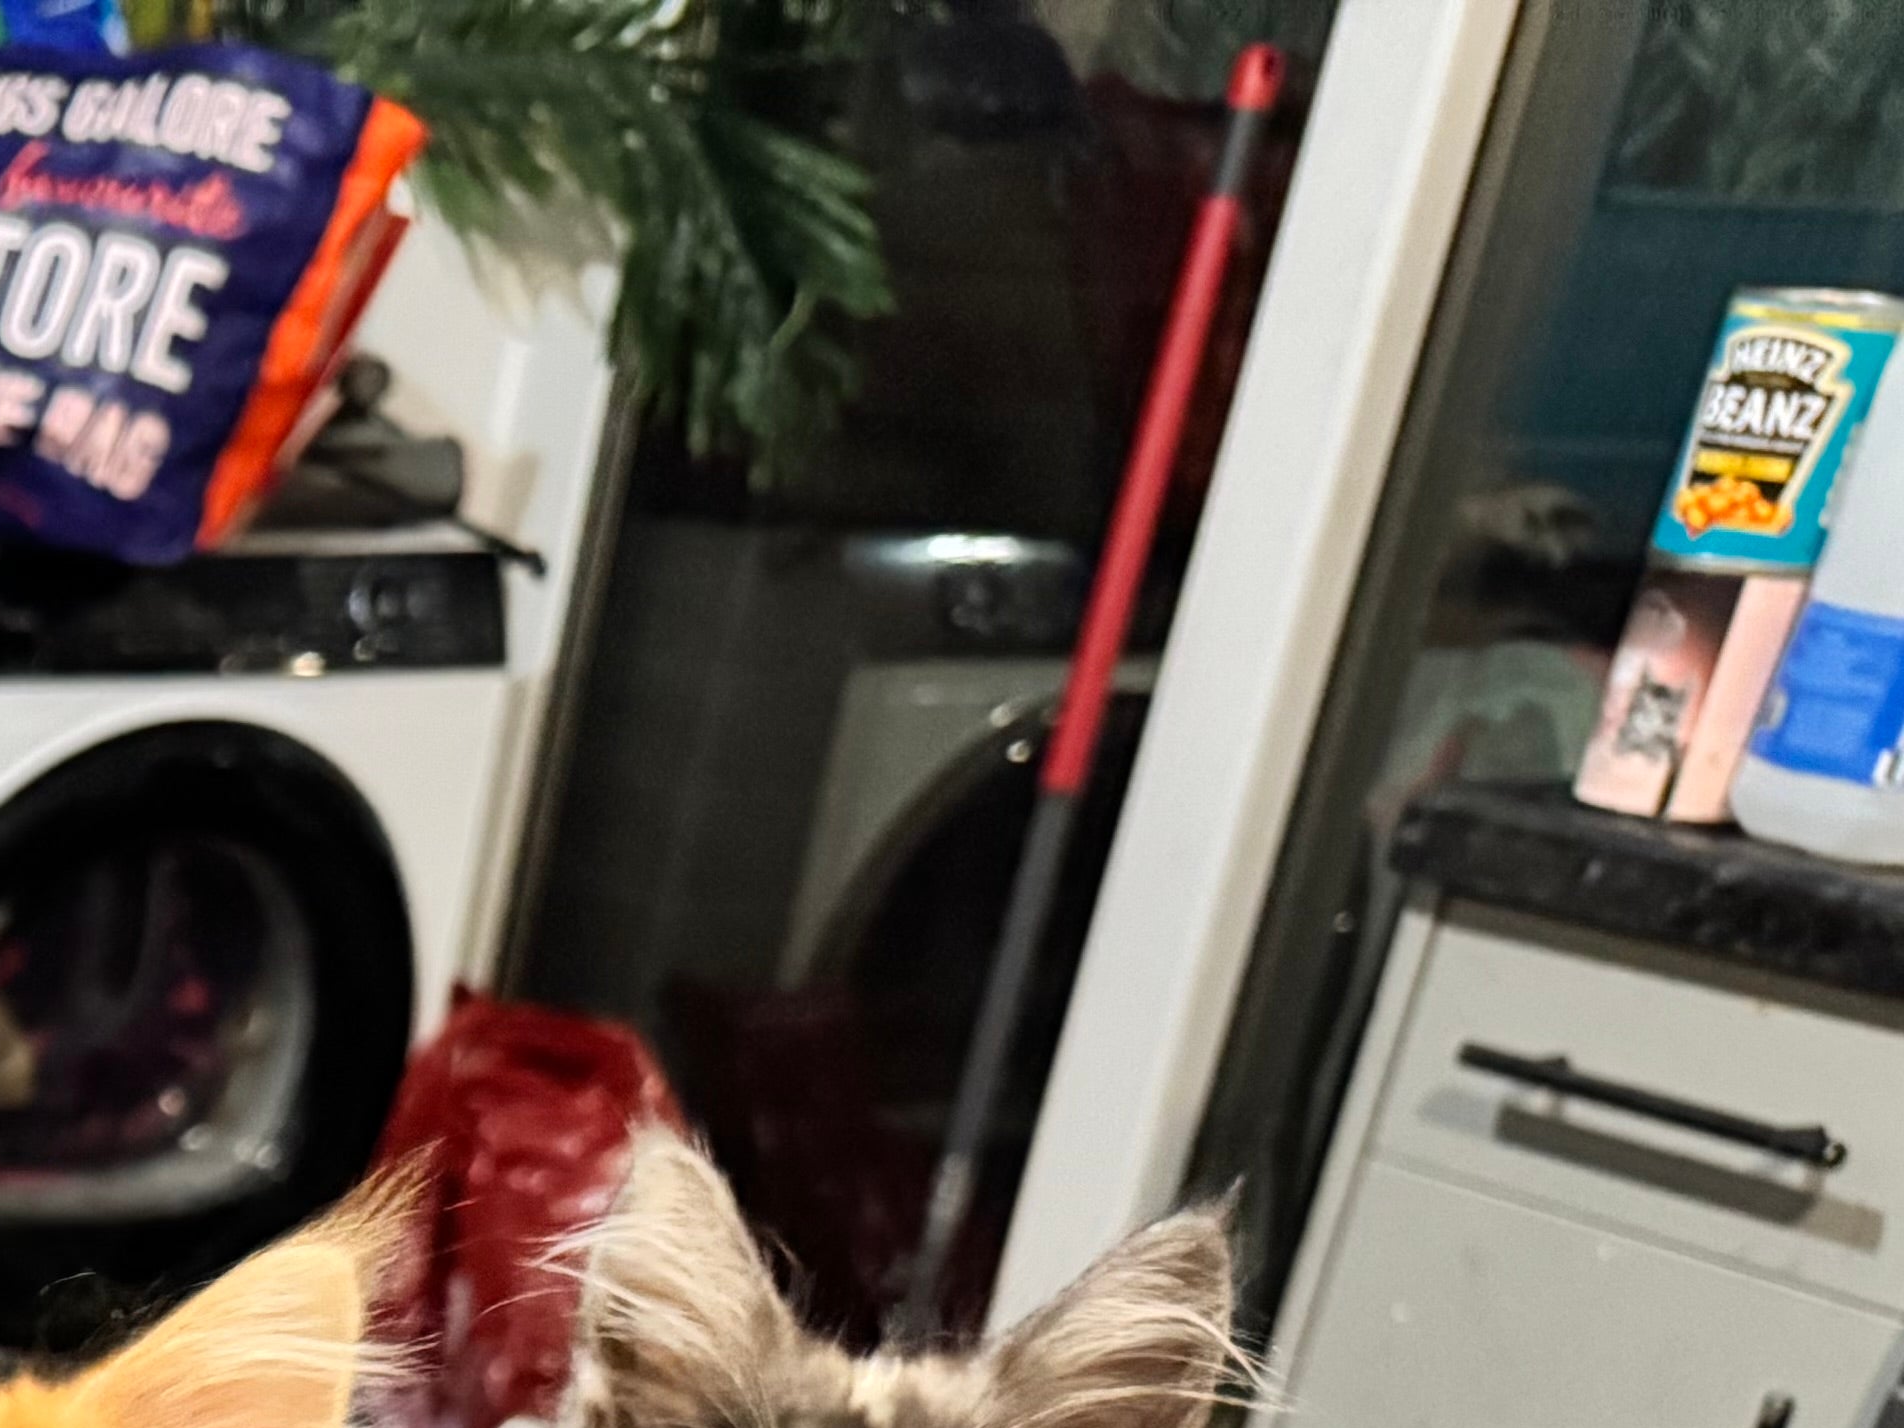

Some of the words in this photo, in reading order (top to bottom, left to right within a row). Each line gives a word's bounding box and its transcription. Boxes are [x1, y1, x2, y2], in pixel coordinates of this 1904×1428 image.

[61, 72, 292, 174] GALORE
[1730, 336, 1829, 385] HEINZ
[35, 386, 172, 502] BAG
[1702, 382, 1828, 440] BEANZ
